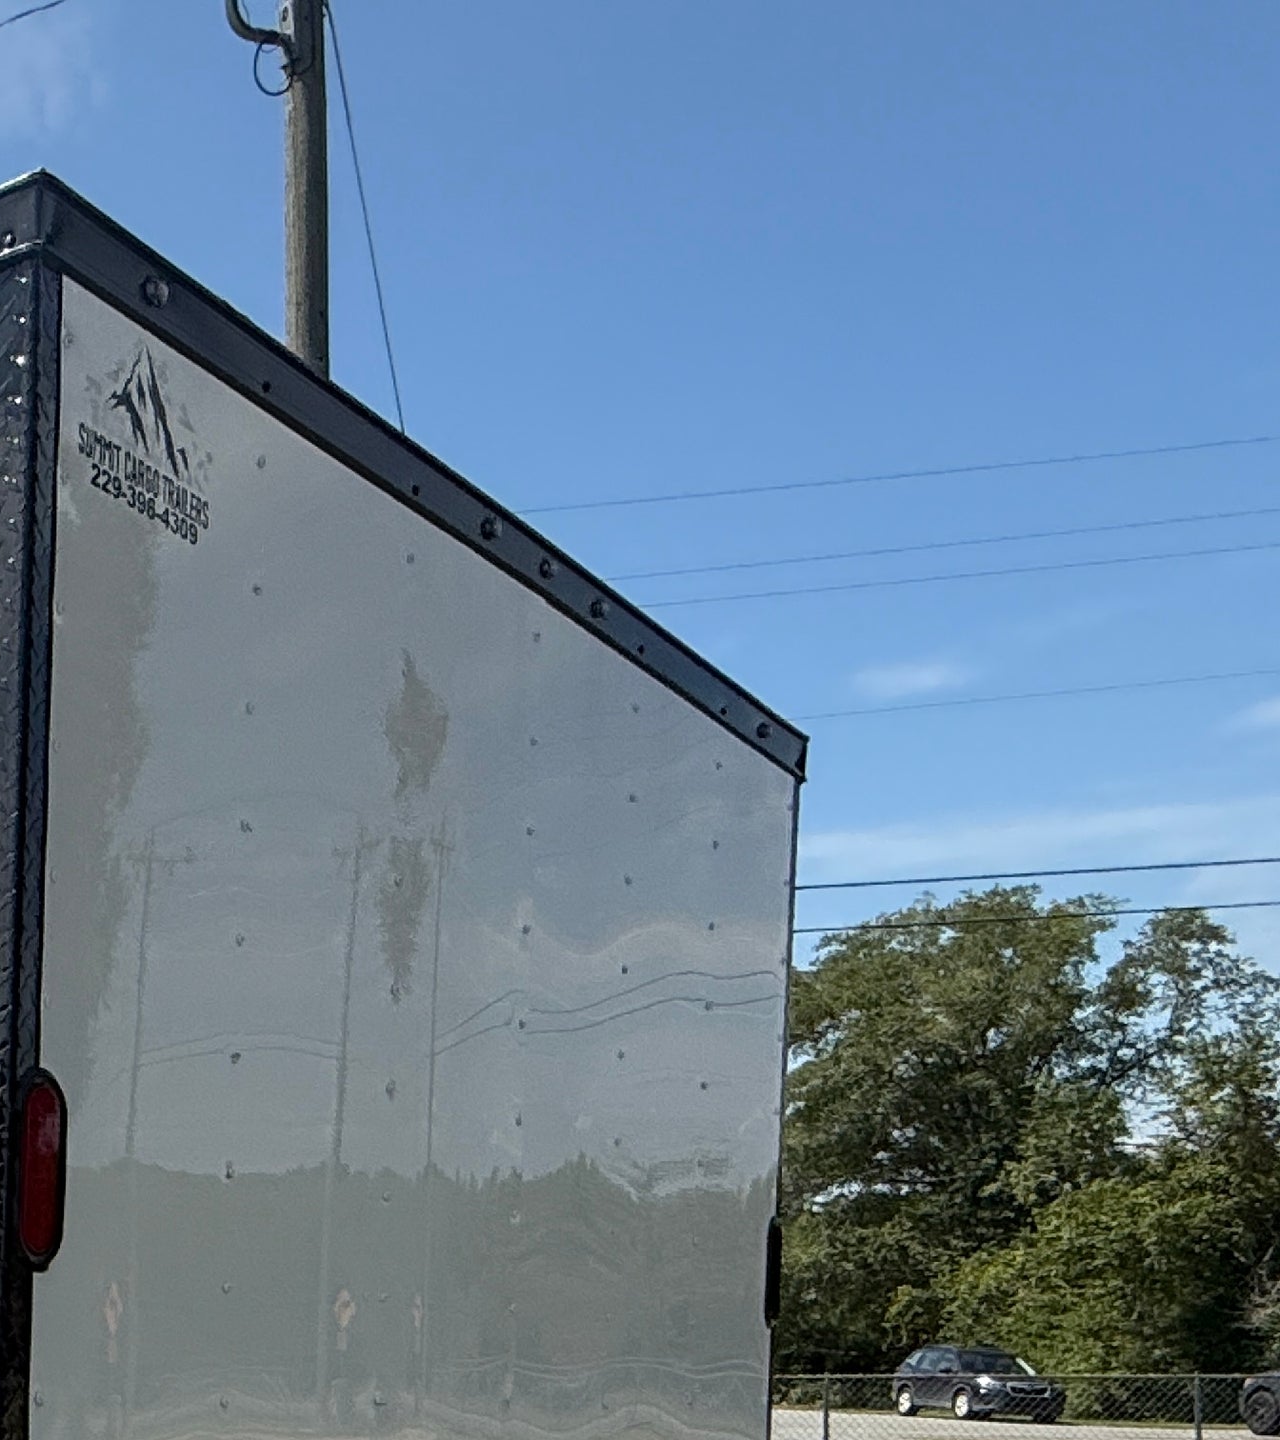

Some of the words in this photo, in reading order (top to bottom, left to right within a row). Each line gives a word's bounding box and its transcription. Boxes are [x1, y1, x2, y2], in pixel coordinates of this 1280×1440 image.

[78, 421, 122, 475] SUMMIT
[124, 450, 160, 499] CARGO
[162, 473, 209, 530] TRAILERS
[91, 462, 198, 545] 229-396-4309
